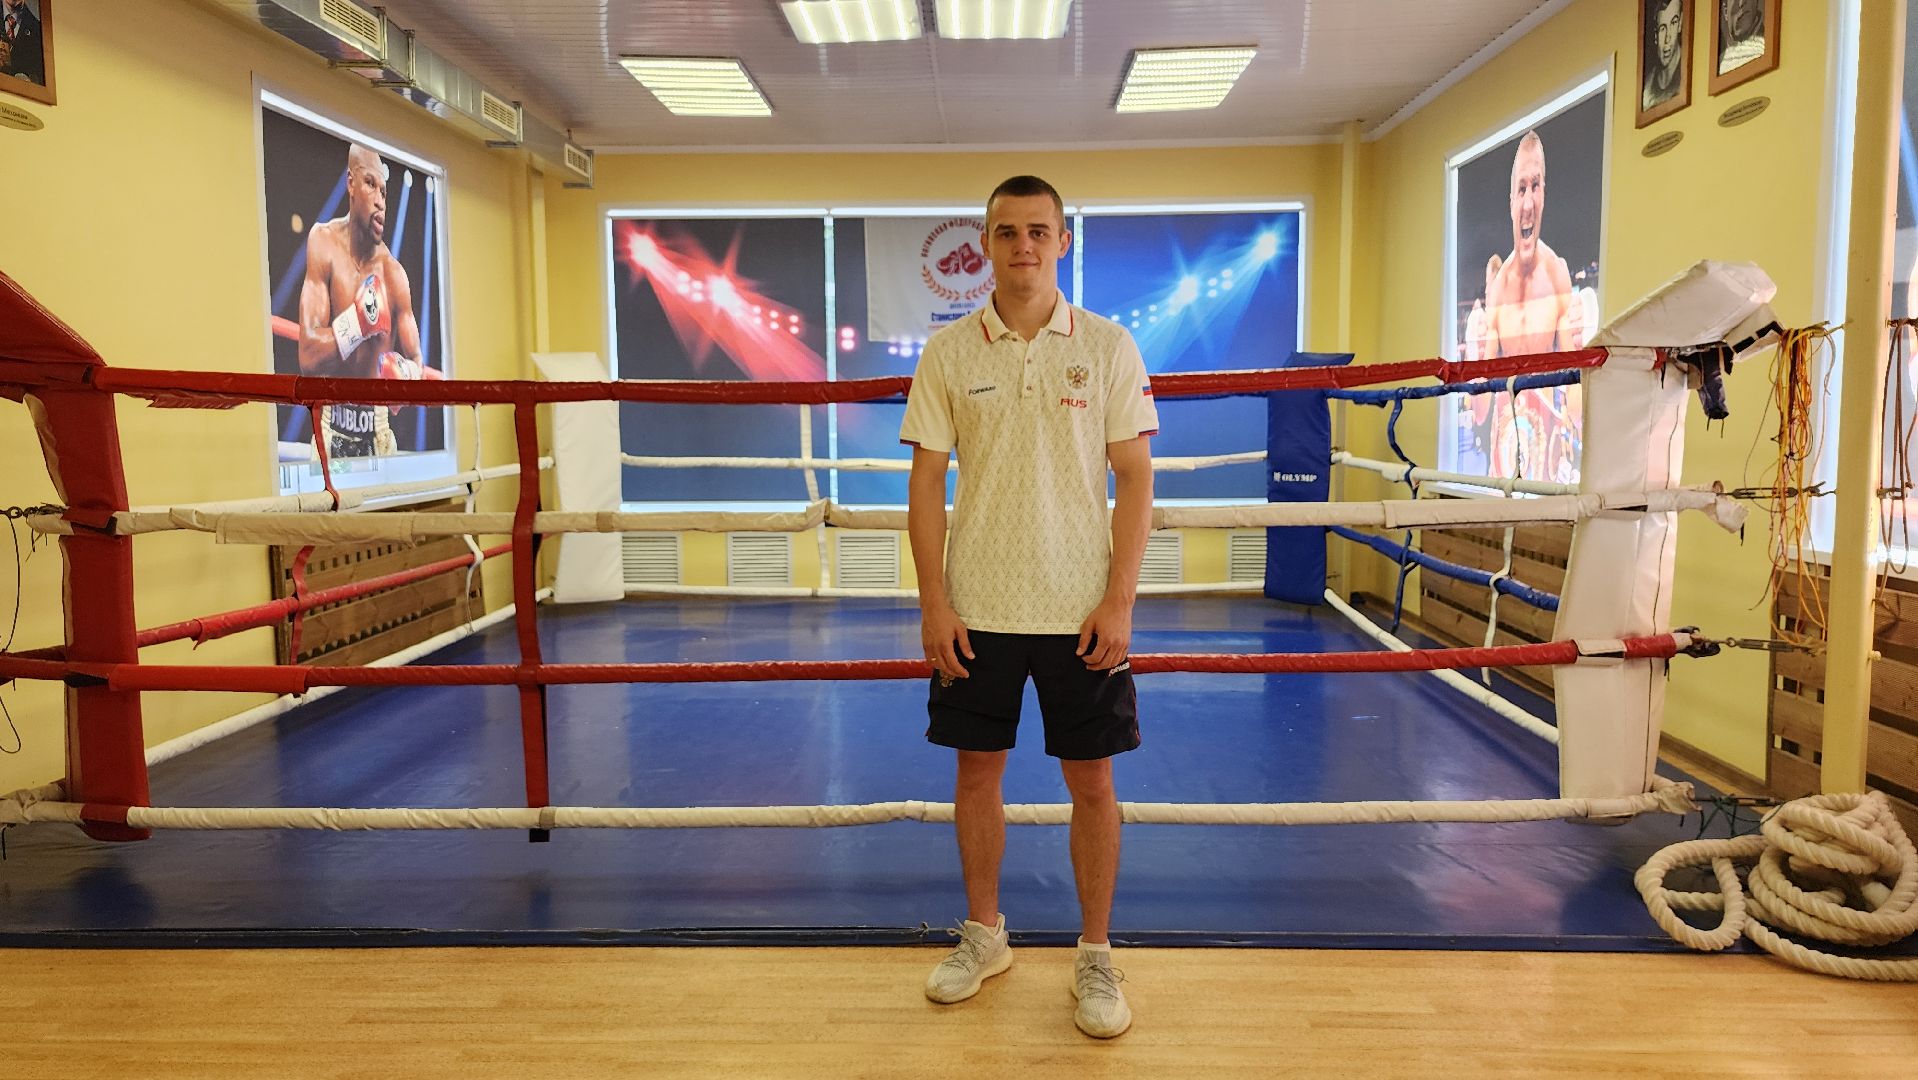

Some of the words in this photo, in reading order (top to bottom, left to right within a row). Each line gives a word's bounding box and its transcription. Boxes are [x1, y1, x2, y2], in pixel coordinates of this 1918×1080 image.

[1060, 397, 1088, 409] RUS
[331, 403, 375, 433] HUBLOT
[1281, 473, 1318, 483] OLYMP
